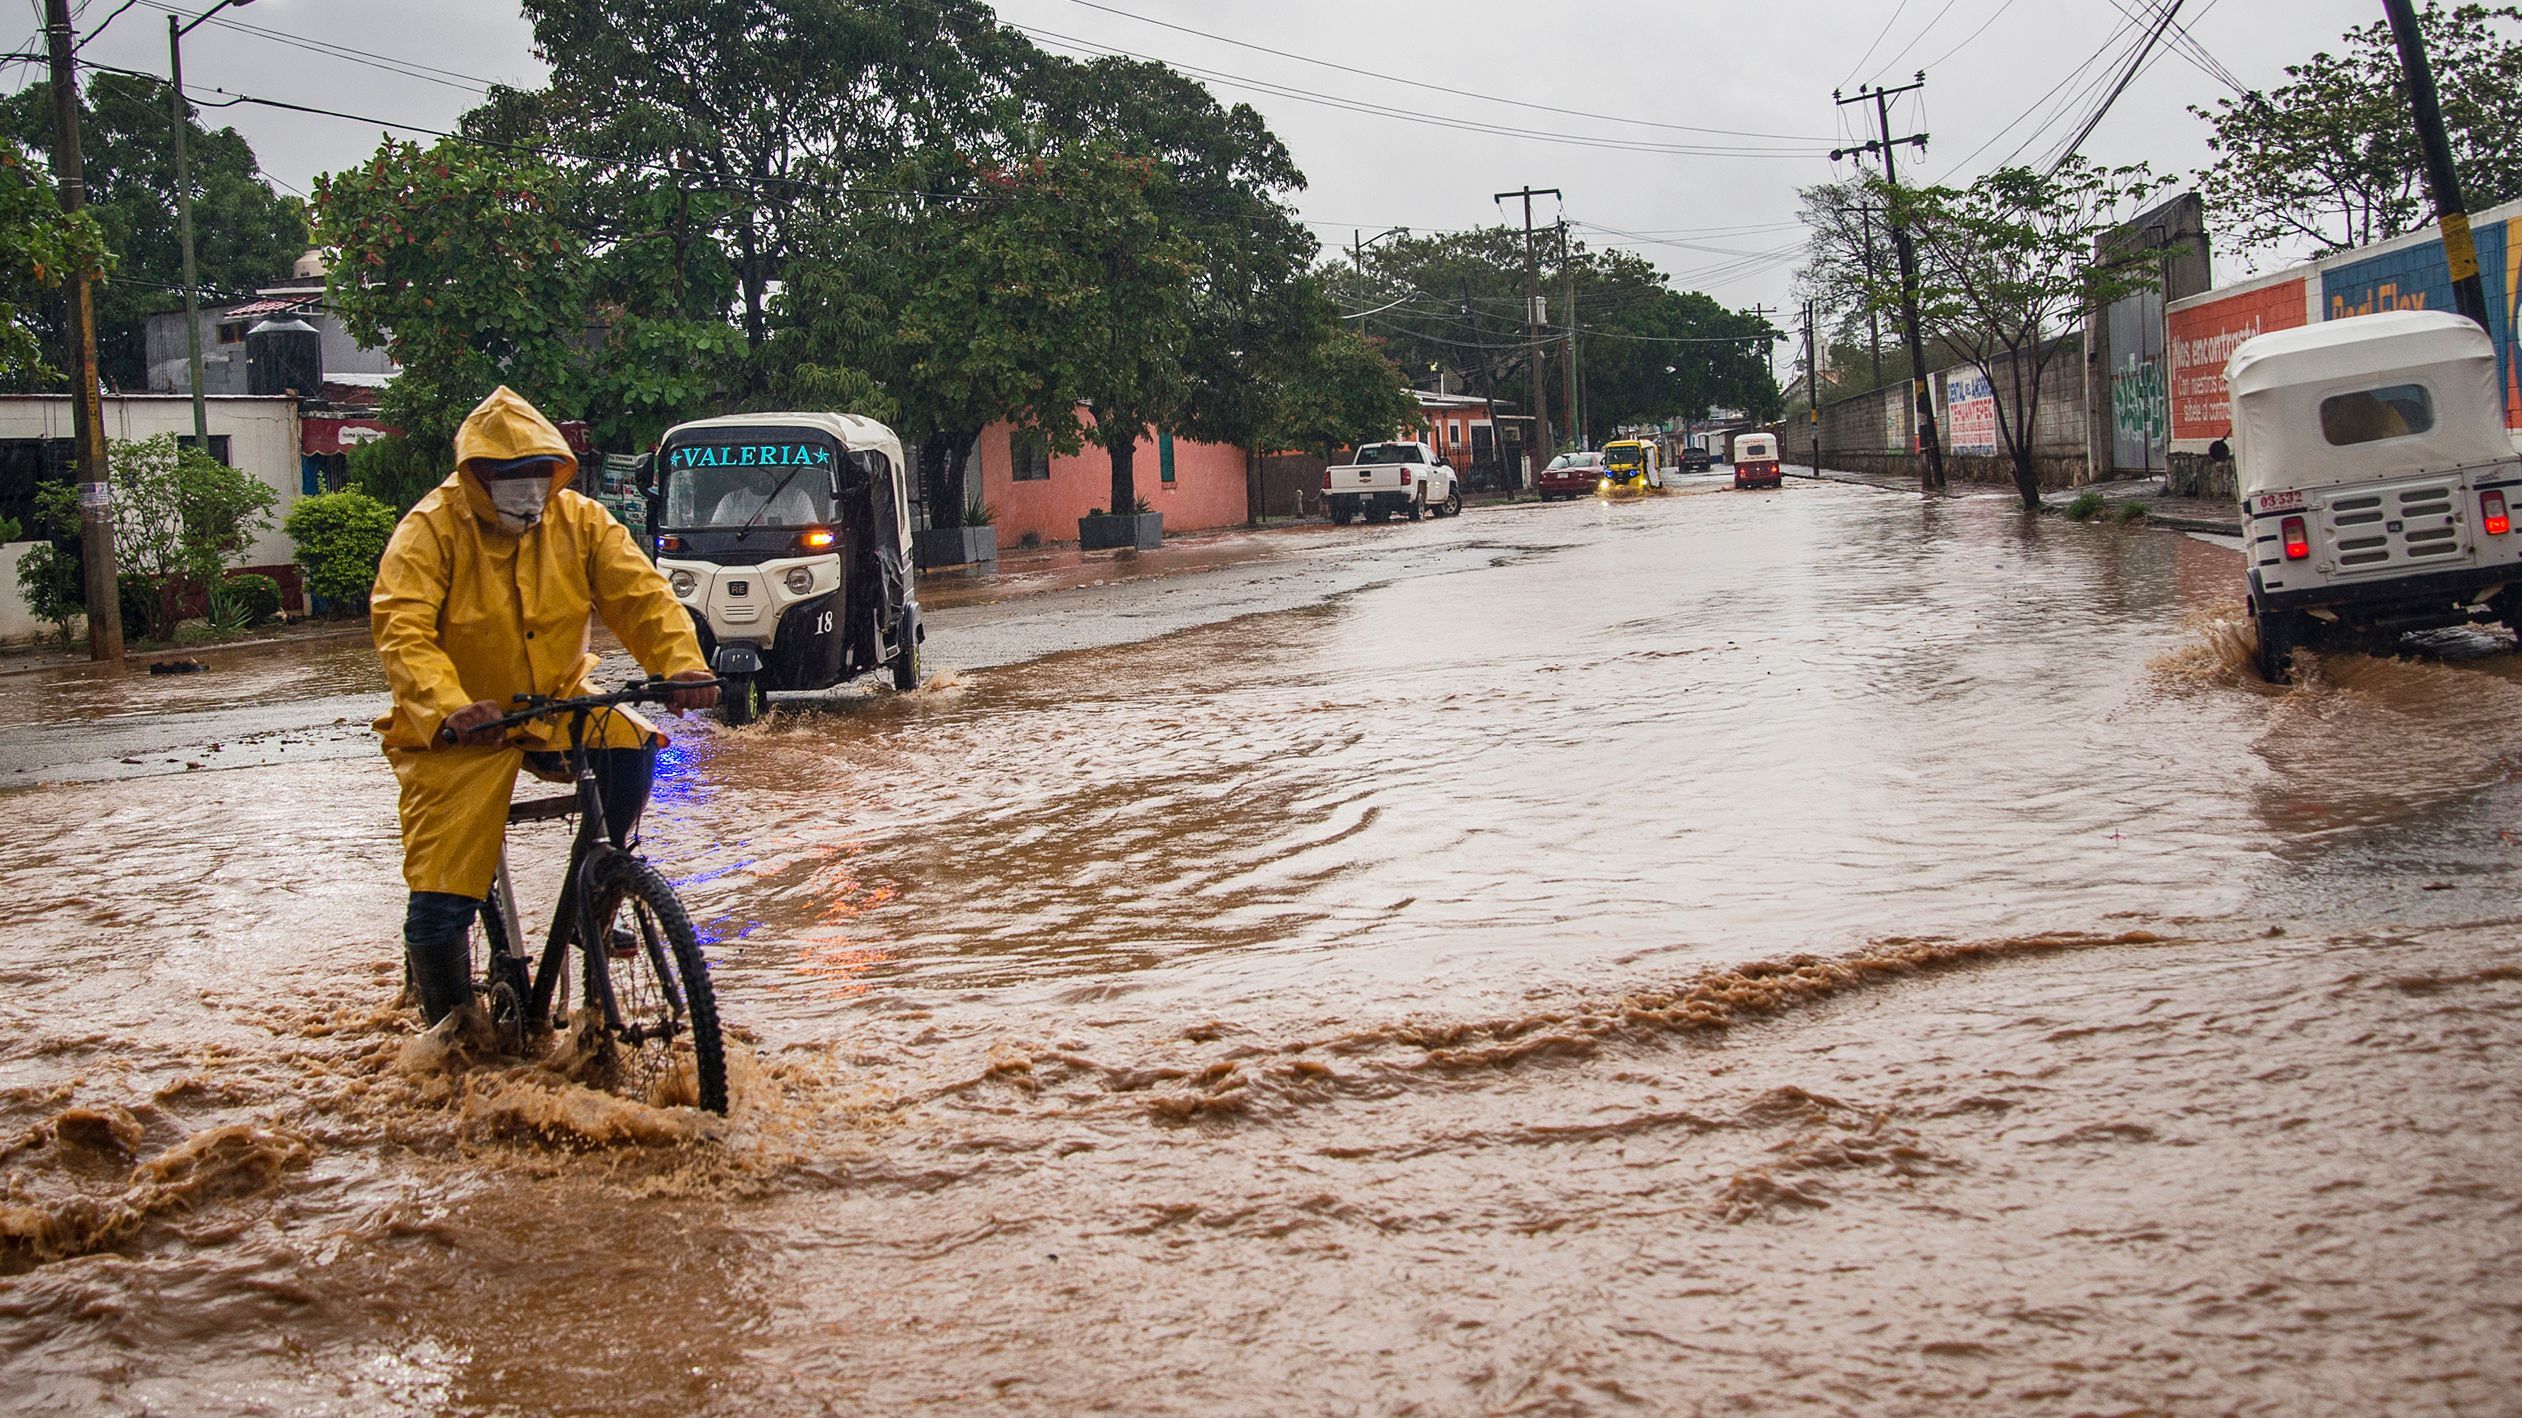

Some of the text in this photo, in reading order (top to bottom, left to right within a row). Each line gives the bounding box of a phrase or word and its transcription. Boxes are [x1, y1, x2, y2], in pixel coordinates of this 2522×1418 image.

[682, 445, 814, 467] VALERIA
[731, 585, 746, 594] RE
[814, 611, 833, 635] 18
